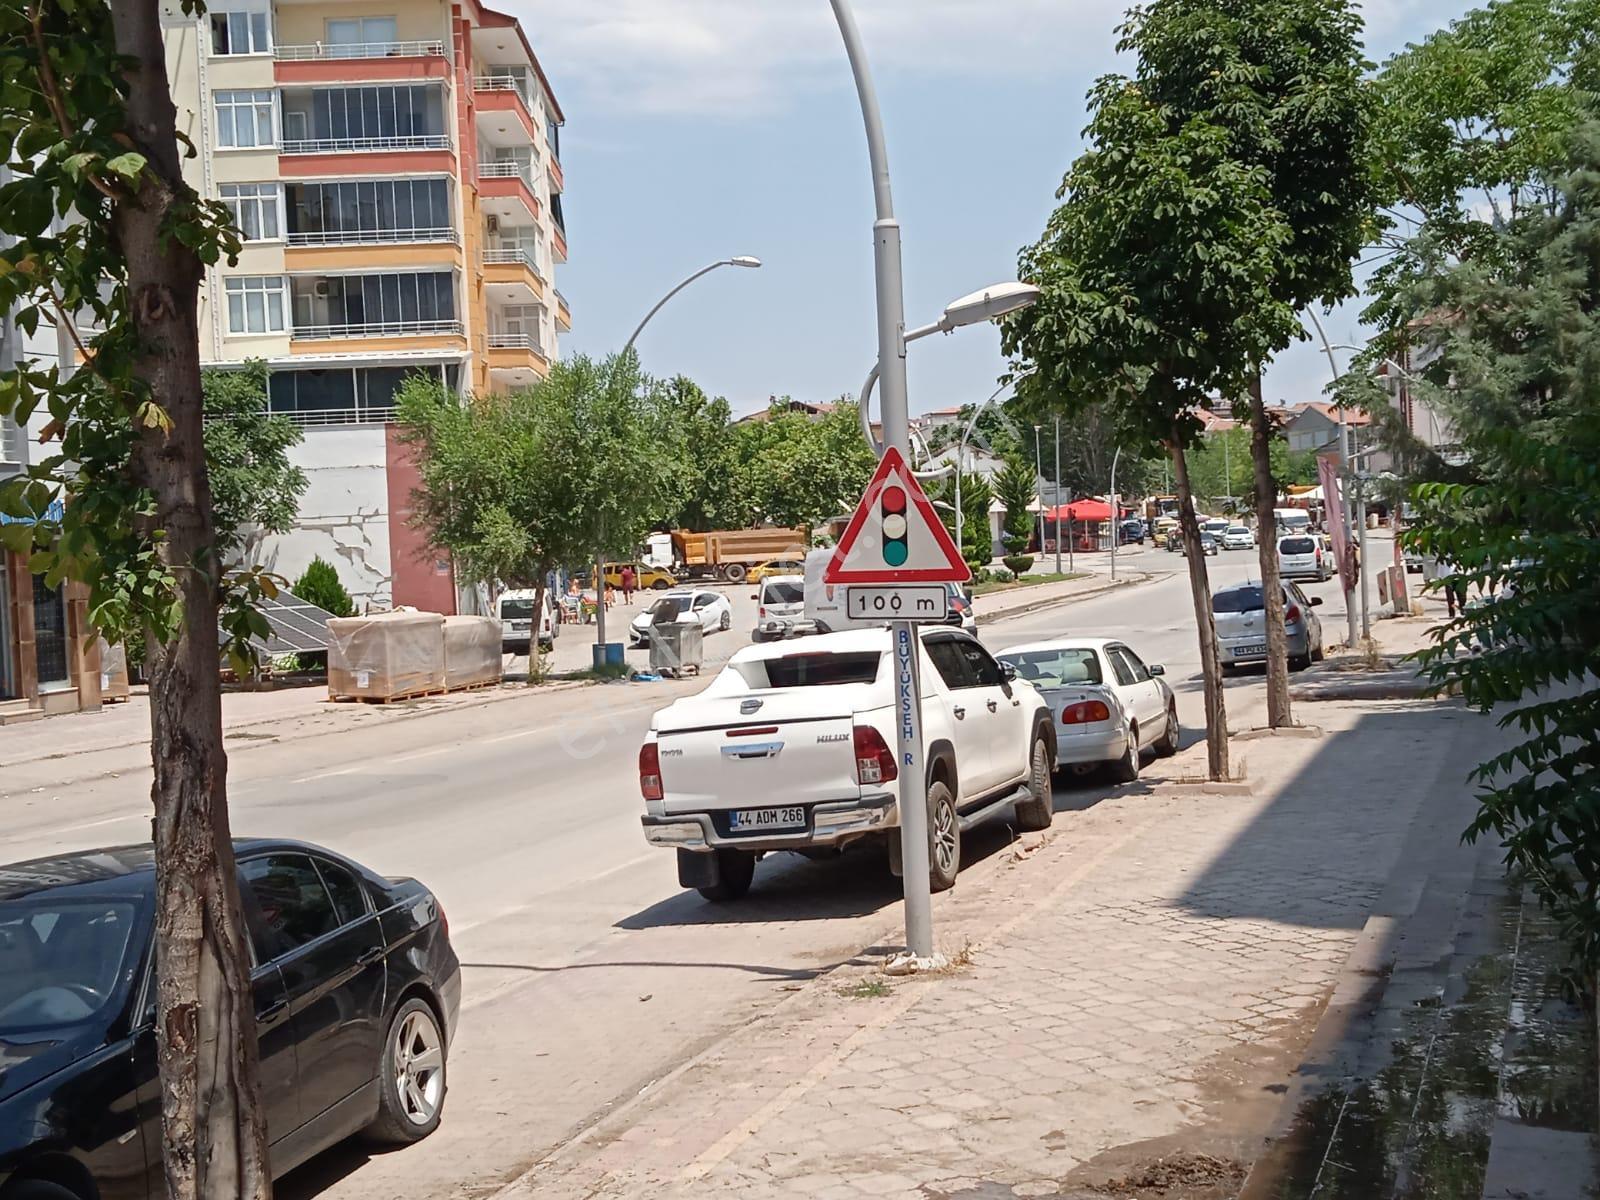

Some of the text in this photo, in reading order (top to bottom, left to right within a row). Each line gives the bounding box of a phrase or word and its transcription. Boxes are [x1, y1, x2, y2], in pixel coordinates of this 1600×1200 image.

[858, 595, 935, 611] 100 m
[738, 812, 752, 826] 44
[782, 809, 803, 822] 266
